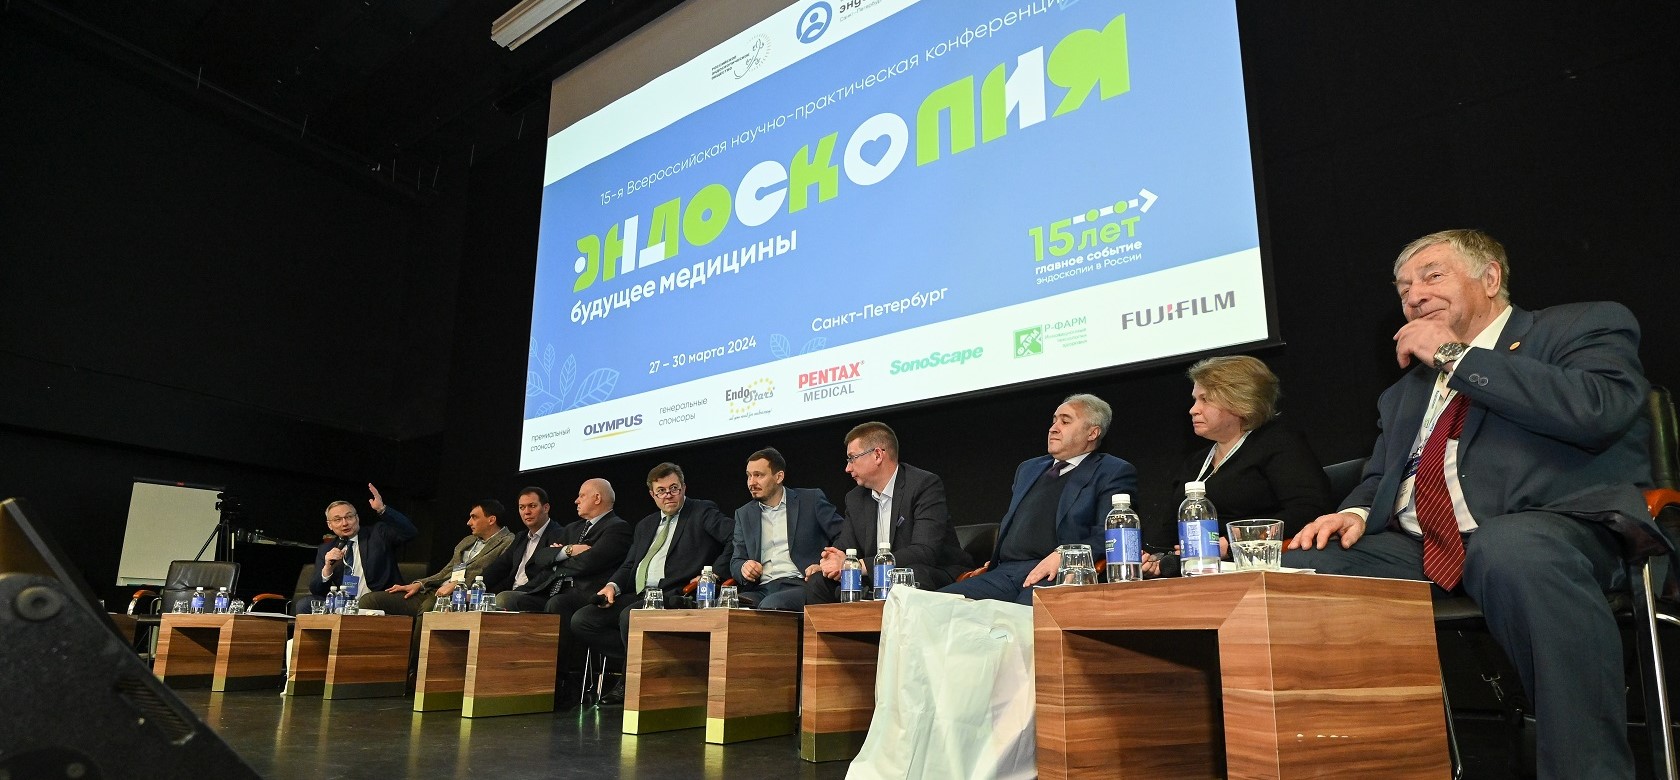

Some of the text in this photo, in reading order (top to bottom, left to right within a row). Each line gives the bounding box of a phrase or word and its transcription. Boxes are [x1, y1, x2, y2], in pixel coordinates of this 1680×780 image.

[600, 189, 624, 206] 15-я
[627, 140, 727, 195] Всероссийская
[731, 54, 919, 148] научно-практическая
[572, 12, 1131, 293] ЭНДОСКОПИЯ
[1029, 215, 1141, 262] 15 лет
[1035, 240, 1143, 275] главное событие
[1036, 252, 1142, 285] эндоскопии в России
[570, 229, 797, 325] будущее медицины
[811, 287, 949, 332] Санкт-Петербург
[1044, 315, 1087, 332] Р-ФАРМ
[1121, 290, 1236, 330] FUJIFILM
[649, 360, 661, 375] 27
[672, 353, 686, 368] 30
[689, 345, 725, 364] марта
[728, 335, 757, 354] 2024
[889, 346, 984, 375] SonoScape
[798, 361, 861, 389] PENTAX
[659, 397, 708, 415] генеральные
[803, 383, 855, 402] MEDICAL
[531, 427, 571, 442] премиальный
[583, 414, 643, 436] OLYMPUS
[658, 412, 696, 427] спонсоры
[530, 441, 556, 452] спонсор
